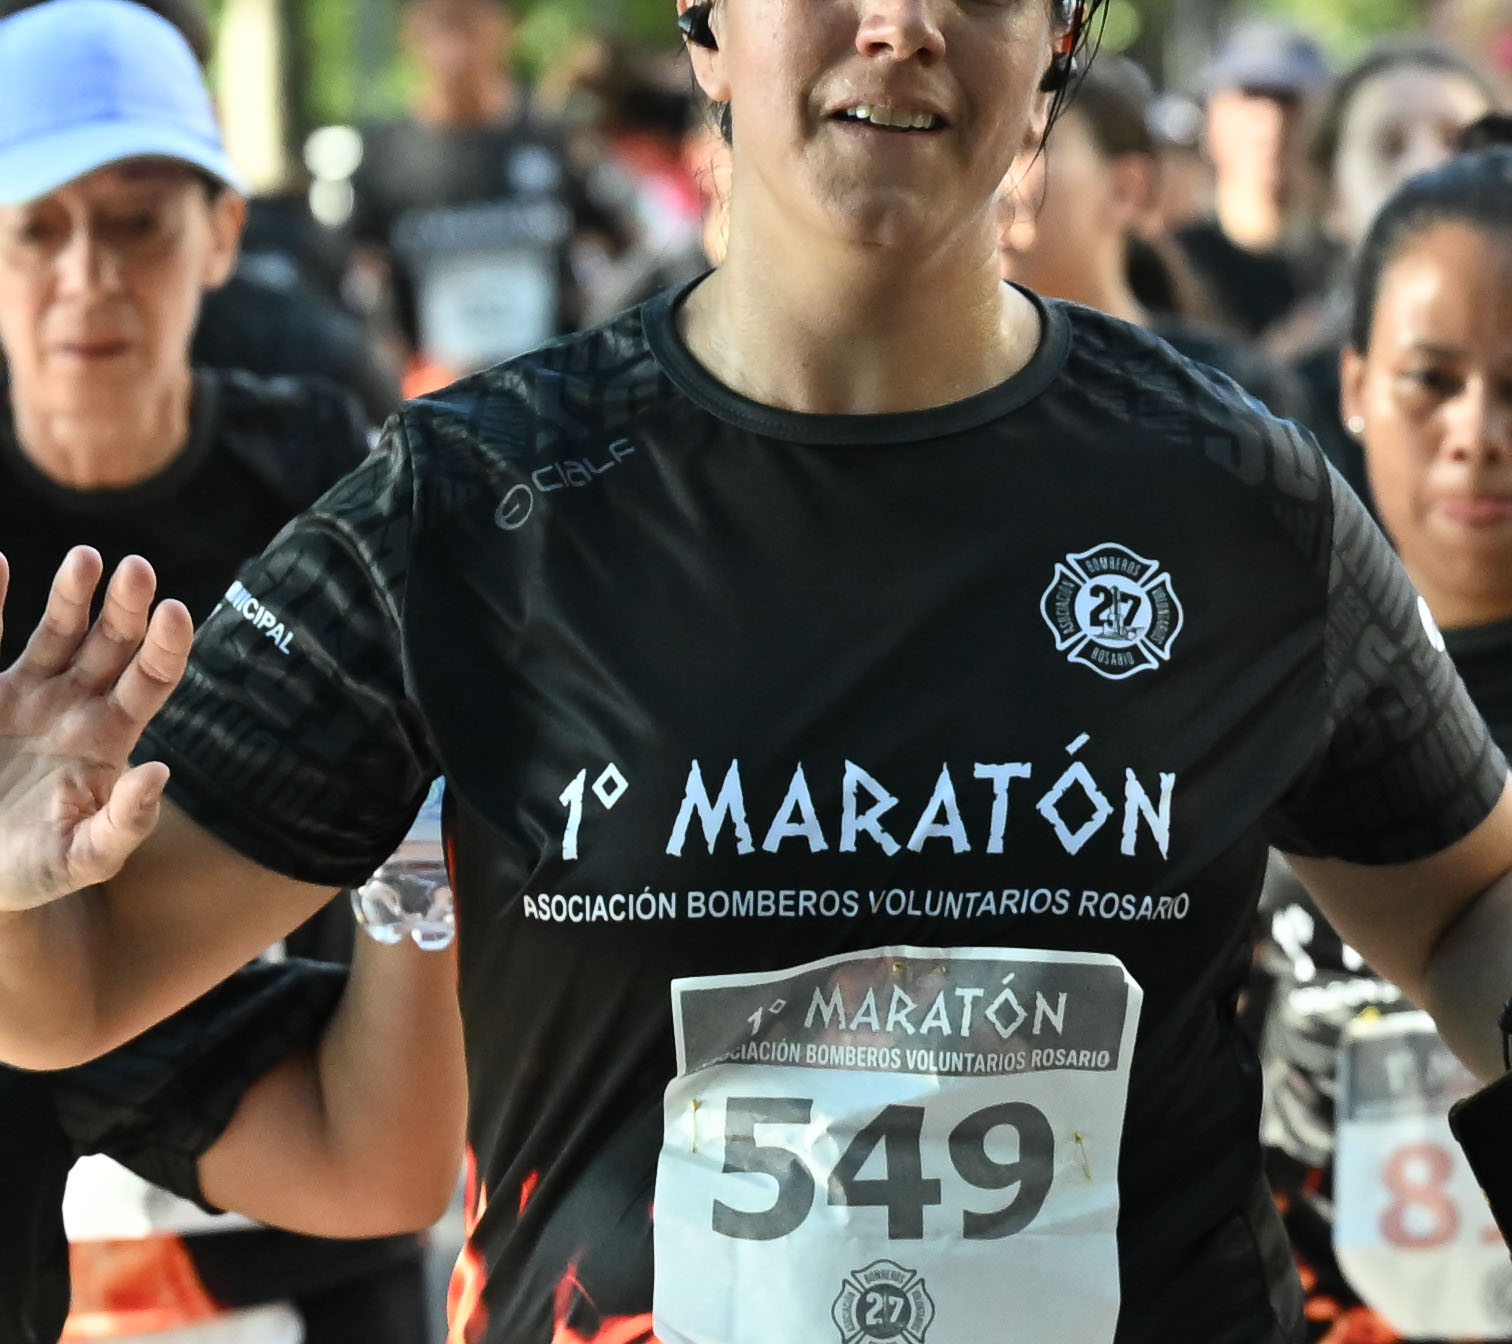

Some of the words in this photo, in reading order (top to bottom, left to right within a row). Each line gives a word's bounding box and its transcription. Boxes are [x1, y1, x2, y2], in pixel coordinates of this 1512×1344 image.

[1085, 556, 1141, 577] BOMBEROS
[1089, 583, 1142, 628] 27
[1090, 646, 1136, 667] ROSARIO
[665, 731, 1177, 861] MARATÓN
[523, 885, 677, 923] ASOCIACIÓN
[687, 888, 859, 919] BOMBEROS
[868, 887, 1071, 920] VOLUNTARIOS
[1078, 889, 1190, 921] ROSARIO
[804, 972, 1068, 1039] MARATÓN
[805, 1043, 900, 1068] BOMBEROS
[904, 1047, 1029, 1074] VOLUNTARIOS
[1030, 1048, 1111, 1069] ROSARIO
[711, 1096, 1057, 1242] 549
[865, 1291, 905, 1326] 27
